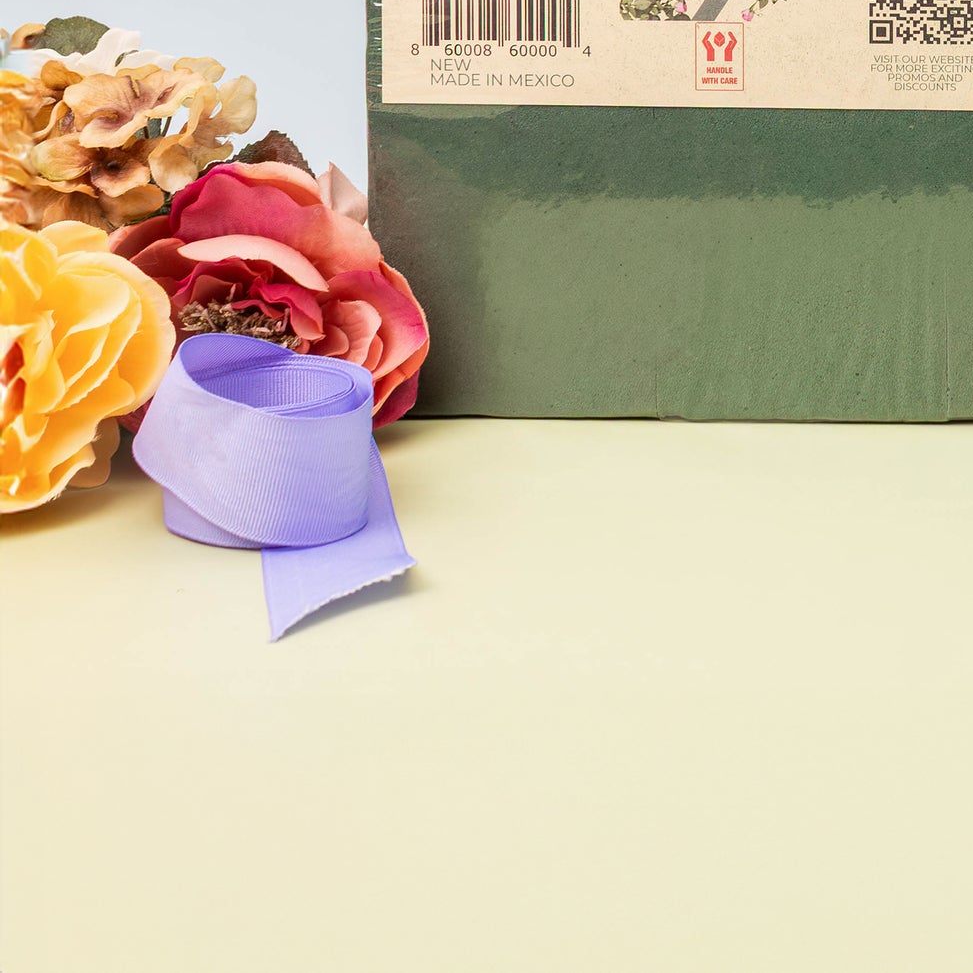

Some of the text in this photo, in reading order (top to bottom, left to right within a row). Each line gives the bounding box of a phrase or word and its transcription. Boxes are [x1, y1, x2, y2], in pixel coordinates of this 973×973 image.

[411, 44, 592, 58] 8 60008 60000 4
[874, 55, 898, 63] VISIT
[901, 55, 926, 63] OUR
[430, 59, 472, 72] NEW
[870, 64, 892, 72] FOR
[896, 64, 928, 72] MORE
[430, 74, 575, 87] MADE IN MEXICO
[702, 77, 738, 85] WITH CARE
[888, 74, 963, 82] PROMOS AND
[895, 83, 957, 91] DISCOUNTS
